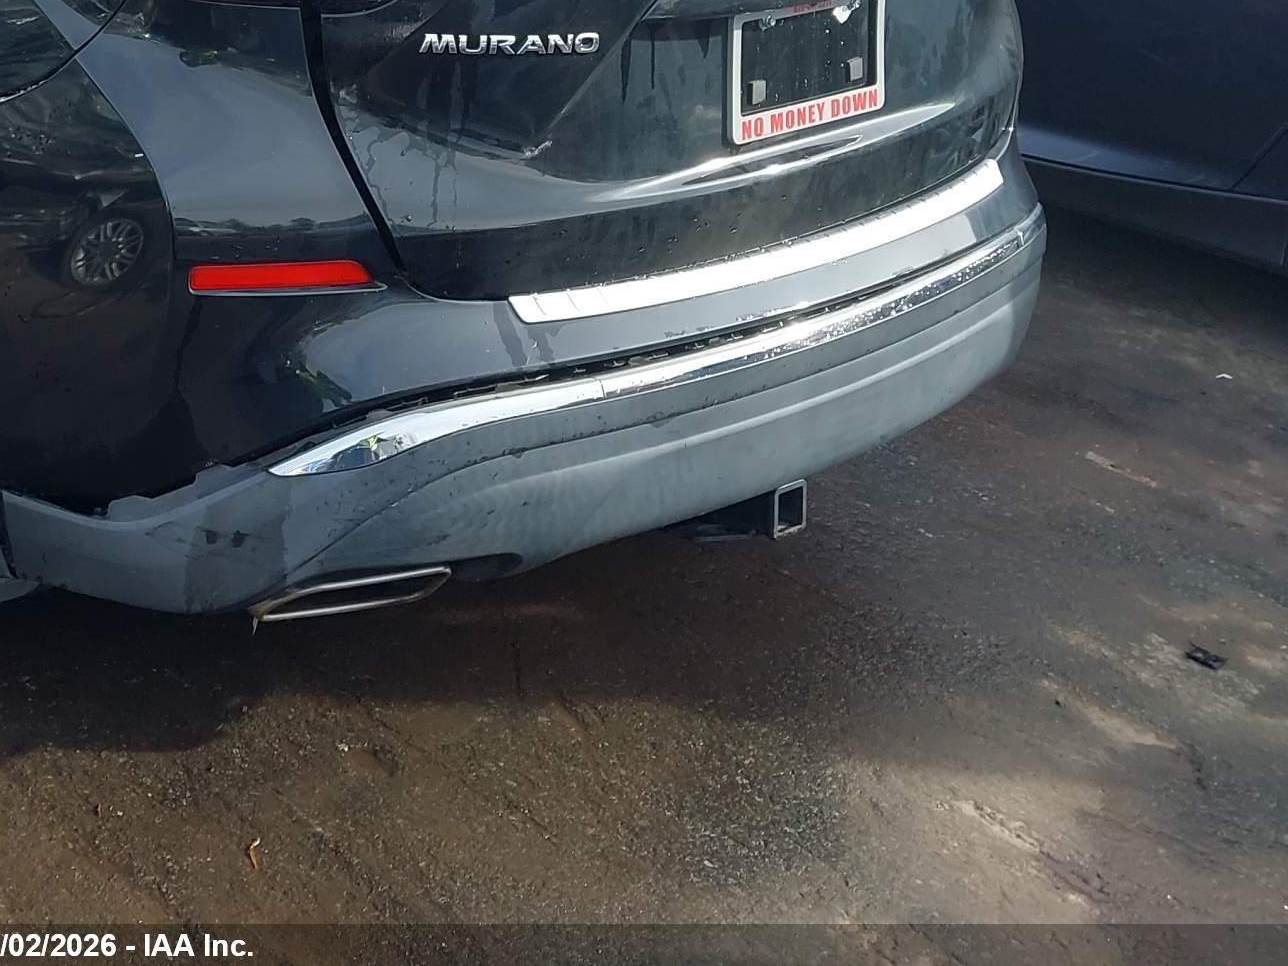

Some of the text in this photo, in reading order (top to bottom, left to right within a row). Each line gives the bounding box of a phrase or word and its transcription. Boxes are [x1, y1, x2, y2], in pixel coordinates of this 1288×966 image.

[419, 32, 600, 55] MURANO
[741, 89, 878, 141] NO MONEY DOWN
